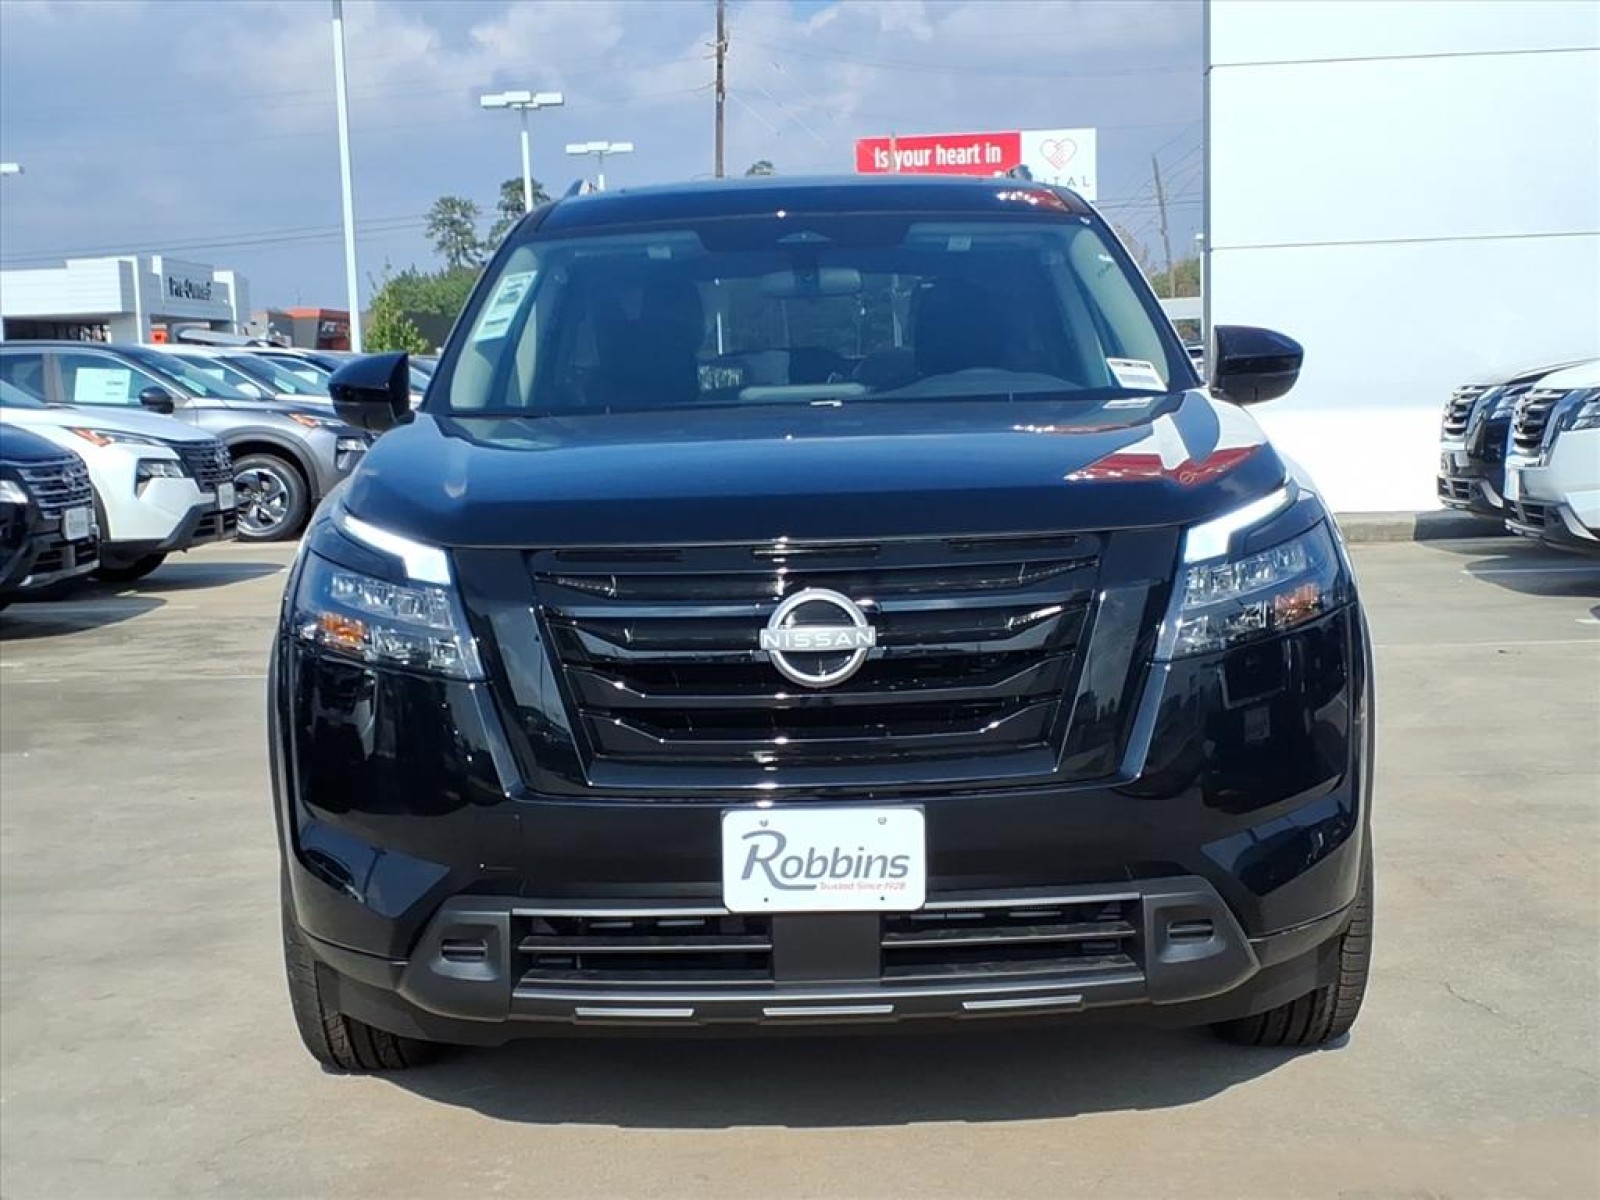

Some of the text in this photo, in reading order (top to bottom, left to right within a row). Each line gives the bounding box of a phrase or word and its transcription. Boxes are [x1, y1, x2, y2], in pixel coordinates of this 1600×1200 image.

[874, 142, 1001, 170] Is your heart in
[762, 630, 873, 648] NISSAN
[741, 829, 911, 891] Robbins
[819, 881, 854, 890] Trusted
[857, 881, 882, 890] Since
